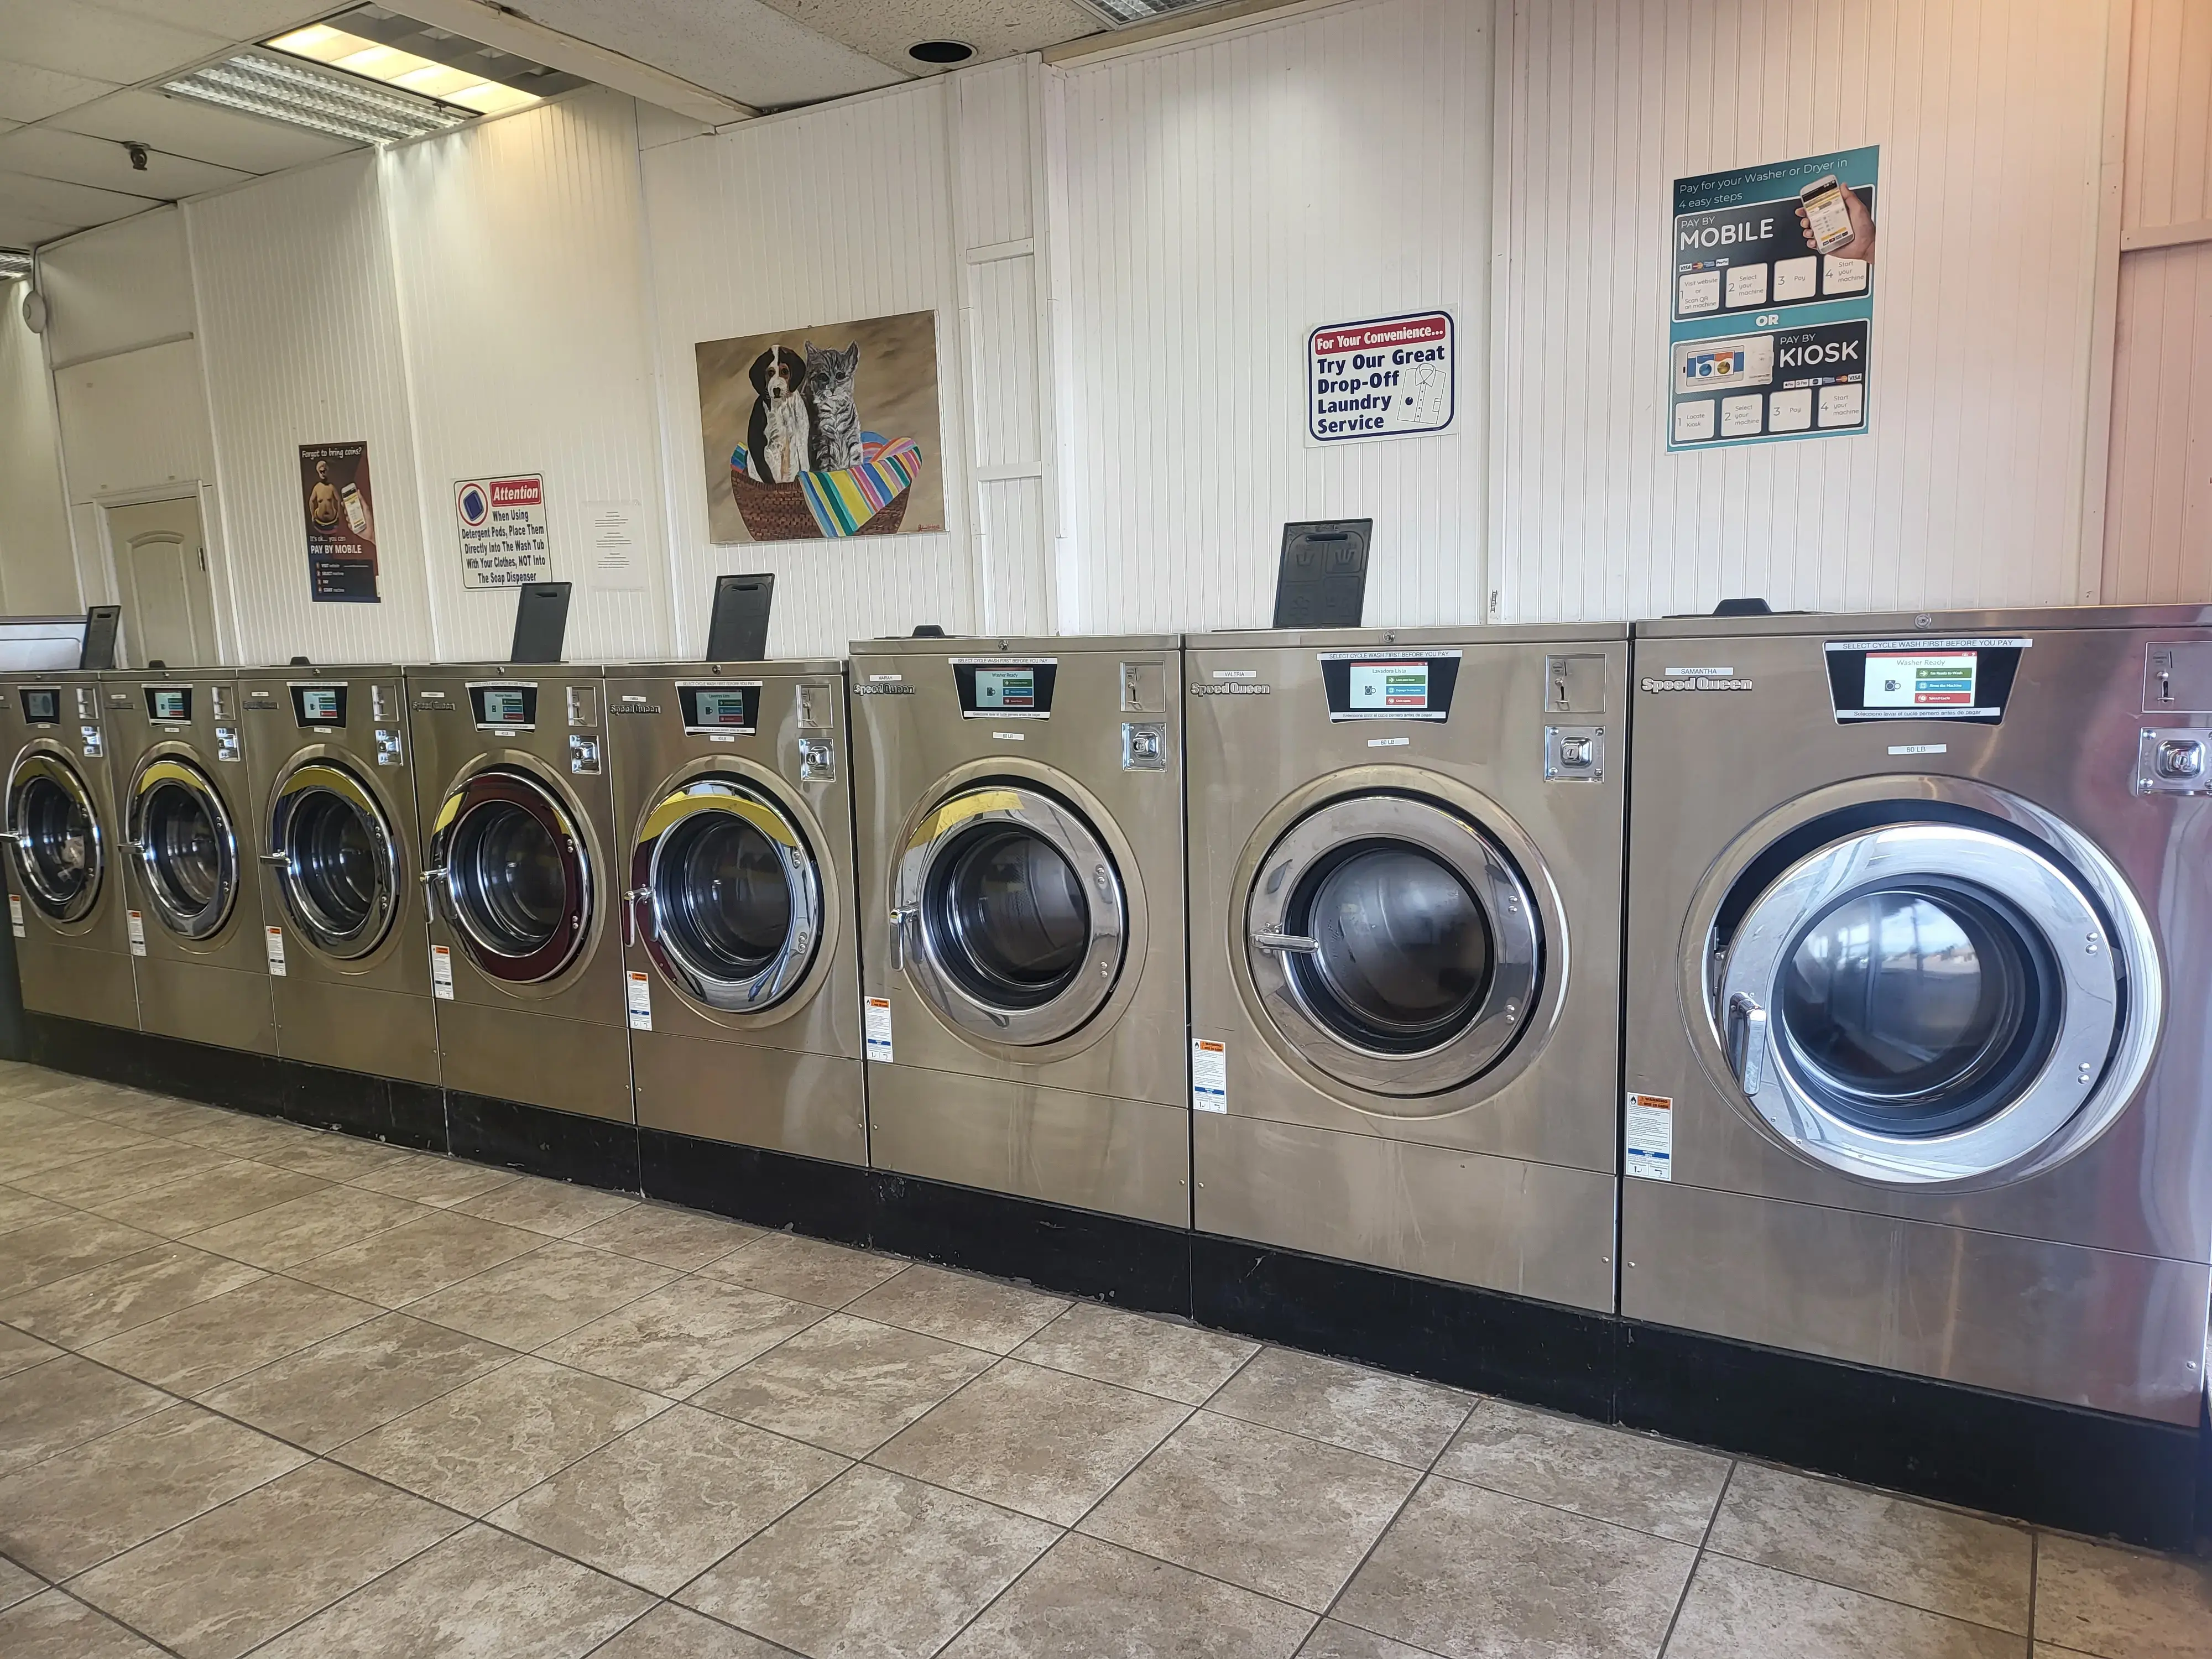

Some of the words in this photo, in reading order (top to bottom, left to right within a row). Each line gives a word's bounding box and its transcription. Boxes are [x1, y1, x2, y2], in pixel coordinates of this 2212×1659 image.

[1679, 183, 1699, 194] Pay
[1702, 180, 1715, 191] for
[1718, 178, 1741, 189] your
[1745, 170, 1787, 184] Washer
[1789, 168, 1801, 176] or
[1804, 161, 1834, 174] Dryer
[1837, 159, 1848, 168] in
[1679, 200, 1686, 208] 4
[1688, 197, 1712, 208] easy
[1714, 192, 1743, 204] steps
[1681, 218, 1699, 228] PAY
[1702, 216, 1715, 226] BY
[1680, 218, 1775, 251] MOBILE
[1778, 276, 1785, 285] 3
[1825, 269, 1834, 278] 4
[1680, 290, 1684, 299] 1
[1728, 283, 1735, 292] 2
[1755, 314, 1779, 327] OR
[1317, 338, 1334, 351] For
[1337, 335, 1361, 347] Your
[1364, 326, 1443, 345] Convenience...
[1780, 335, 1800, 345] PAY
[1802, 333, 1816, 342] BY
[1317, 358, 1346, 375] Try
[1353, 354, 1385, 369] Our
[1392, 345, 1445, 365] Great
[1780, 340, 1859, 368] KIOSK
[1318, 370, 1400, 394] Drop-Off
[1318, 394, 1392, 414] Laundry
[1820, 402, 1829, 411] 4
[1724, 413, 1731, 421] 2
[1773, 407, 1781, 416] 3
[1318, 414, 1384, 434] Service
[1678, 418, 1681, 426] 1
[302, 450, 320, 460] Forgot
[328, 447, 343, 458] bring
[345, 446, 362, 456] coins?
[493, 485, 539, 501] Attention
[492, 510, 509, 521] When
[511, 509, 529, 522] Using
[462, 526, 491, 541] Detergent
[492, 526, 508, 539] Pods,
[509, 525, 526, 536] Place
[527, 524, 544, 535] Them
[310, 545, 323, 554] PAY
[325, 545, 333, 554] BY
[335, 545, 362, 554] MOBILE
[465, 542, 487, 556] Directly
[489, 542, 500, 553] Into
[502, 541, 513, 552] The
[515, 540, 531, 551] Wash
[533, 539, 544, 550] Tub
[466, 558, 479, 569] With
[480, 557, 493, 568] Your
[494, 556, 517, 569] Clothes,
[518, 555, 531, 567] NOT
[533, 555, 545, 566] Into
[478, 573, 489, 584] The
[491, 572, 505, 585] Soap
[507, 571, 536, 585] Dispenser
[854, 684, 884, 696] Speed
[884, 683, 916, 695] Queen
[1191, 682, 1229, 696] Speed
[1230, 682, 1270, 694] Queen
[1642, 677, 1695, 693] Speed
[1696, 676, 1752, 691] Queen
